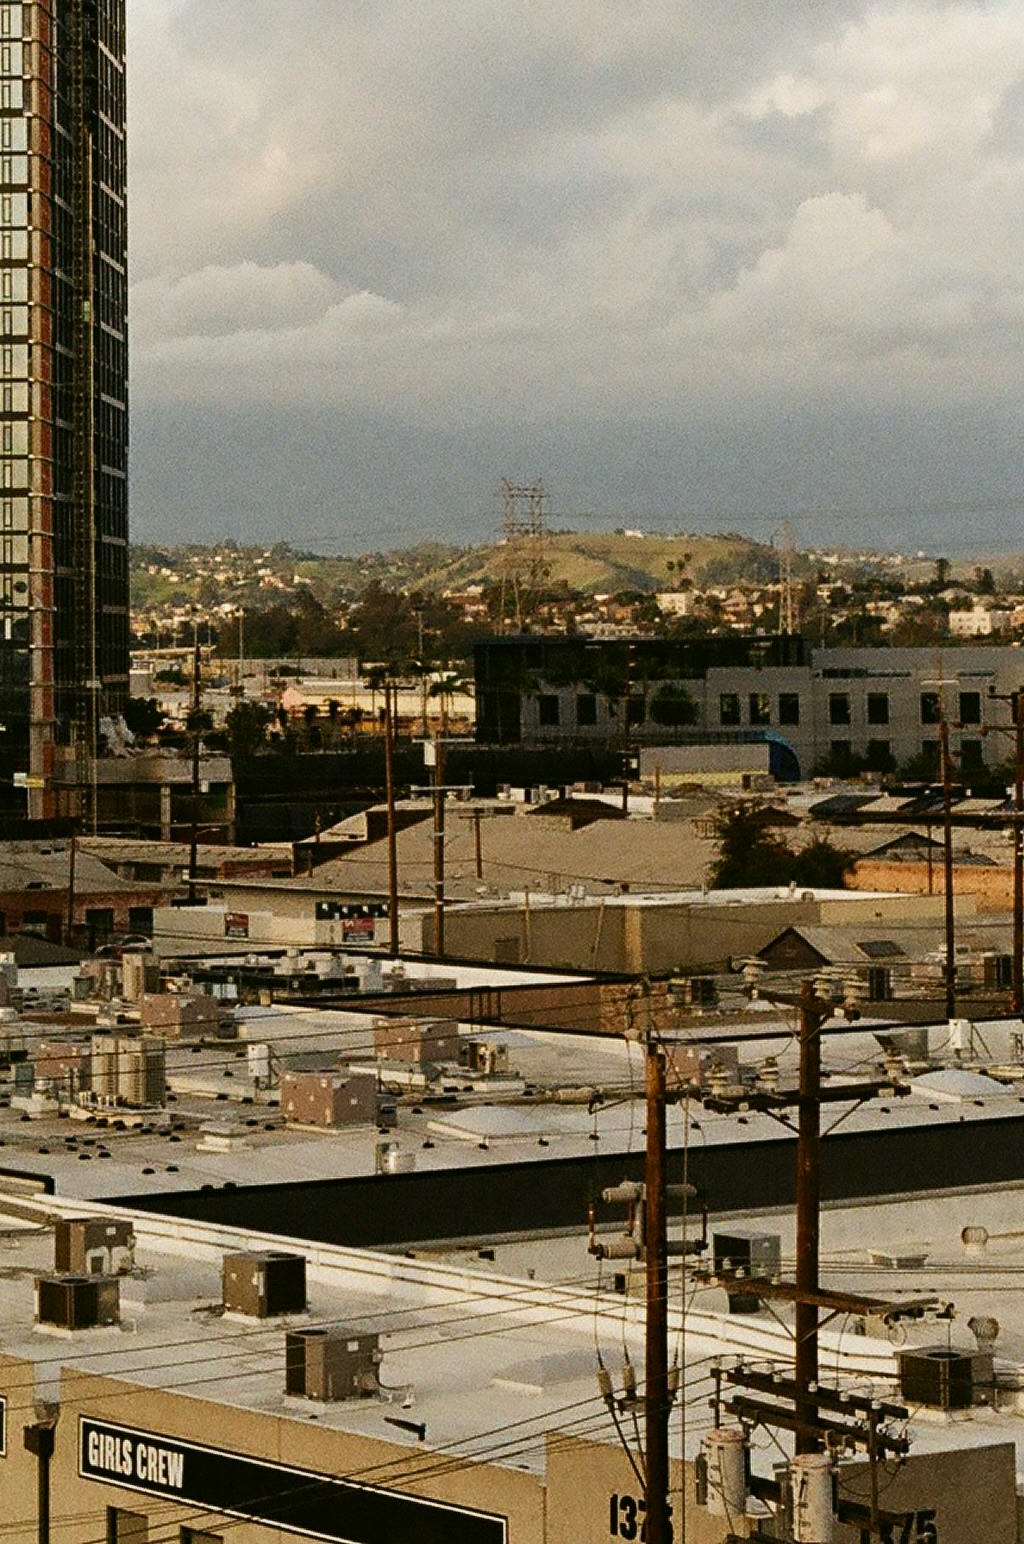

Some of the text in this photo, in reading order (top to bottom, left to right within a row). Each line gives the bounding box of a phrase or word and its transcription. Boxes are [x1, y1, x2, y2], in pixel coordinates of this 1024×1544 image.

[88, 1430, 184, 1489] GIRLS CREW
[610, 1493, 674, 1544] 13
